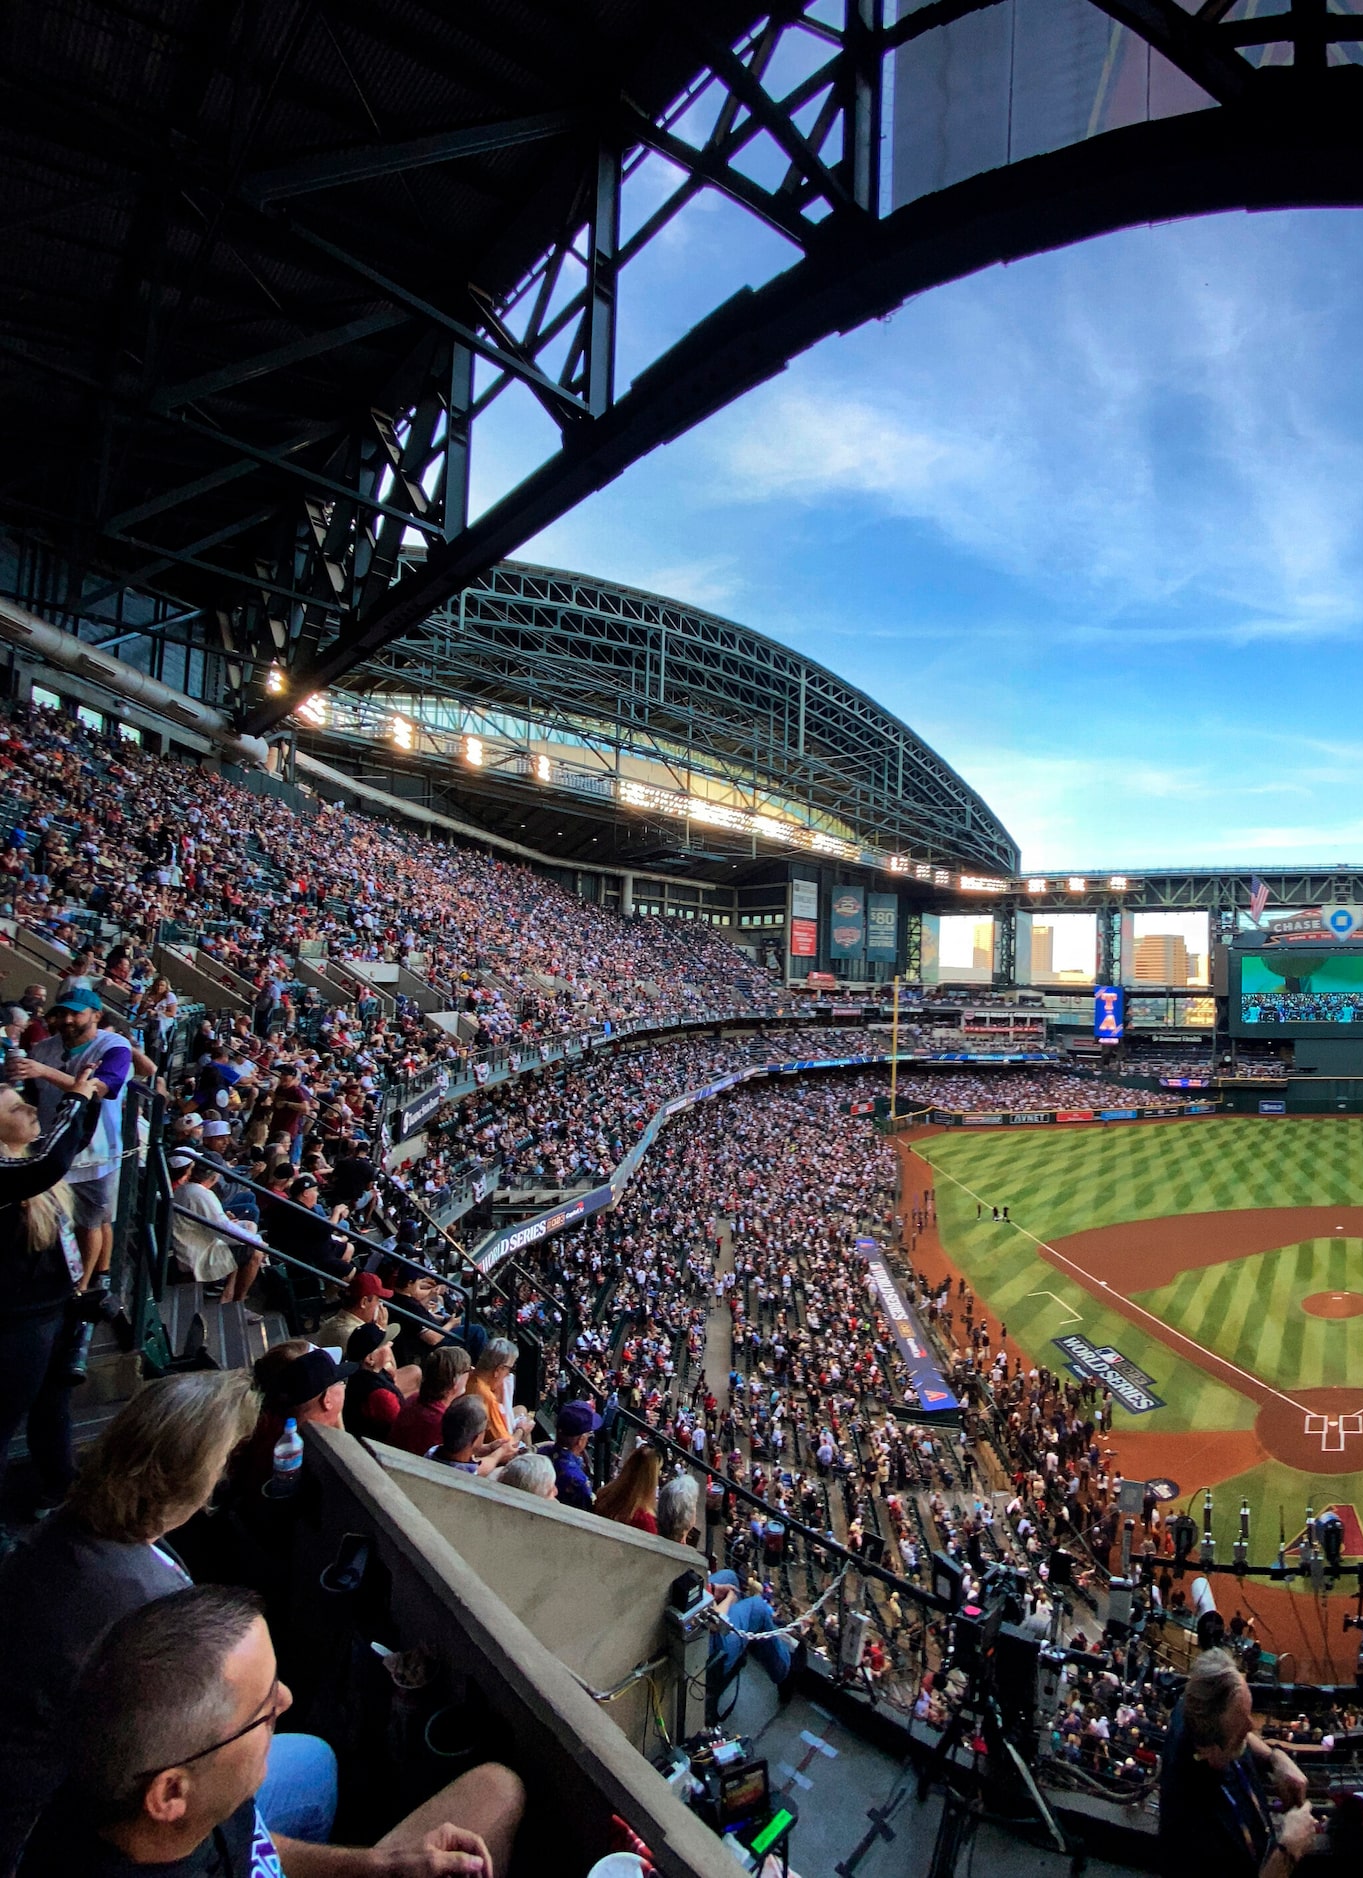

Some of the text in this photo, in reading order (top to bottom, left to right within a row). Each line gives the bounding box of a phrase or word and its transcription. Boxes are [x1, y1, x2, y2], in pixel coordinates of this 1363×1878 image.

[870, 911, 895, 925] $80
[1273, 919, 1321, 933] CHASE
[1014, 1114, 1045, 1122] AVNET
[481, 1238, 509, 1273] WORLD
[509, 1220, 546, 1252] SERIES
[1062, 1337, 1155, 1410] WORLD SERIES
